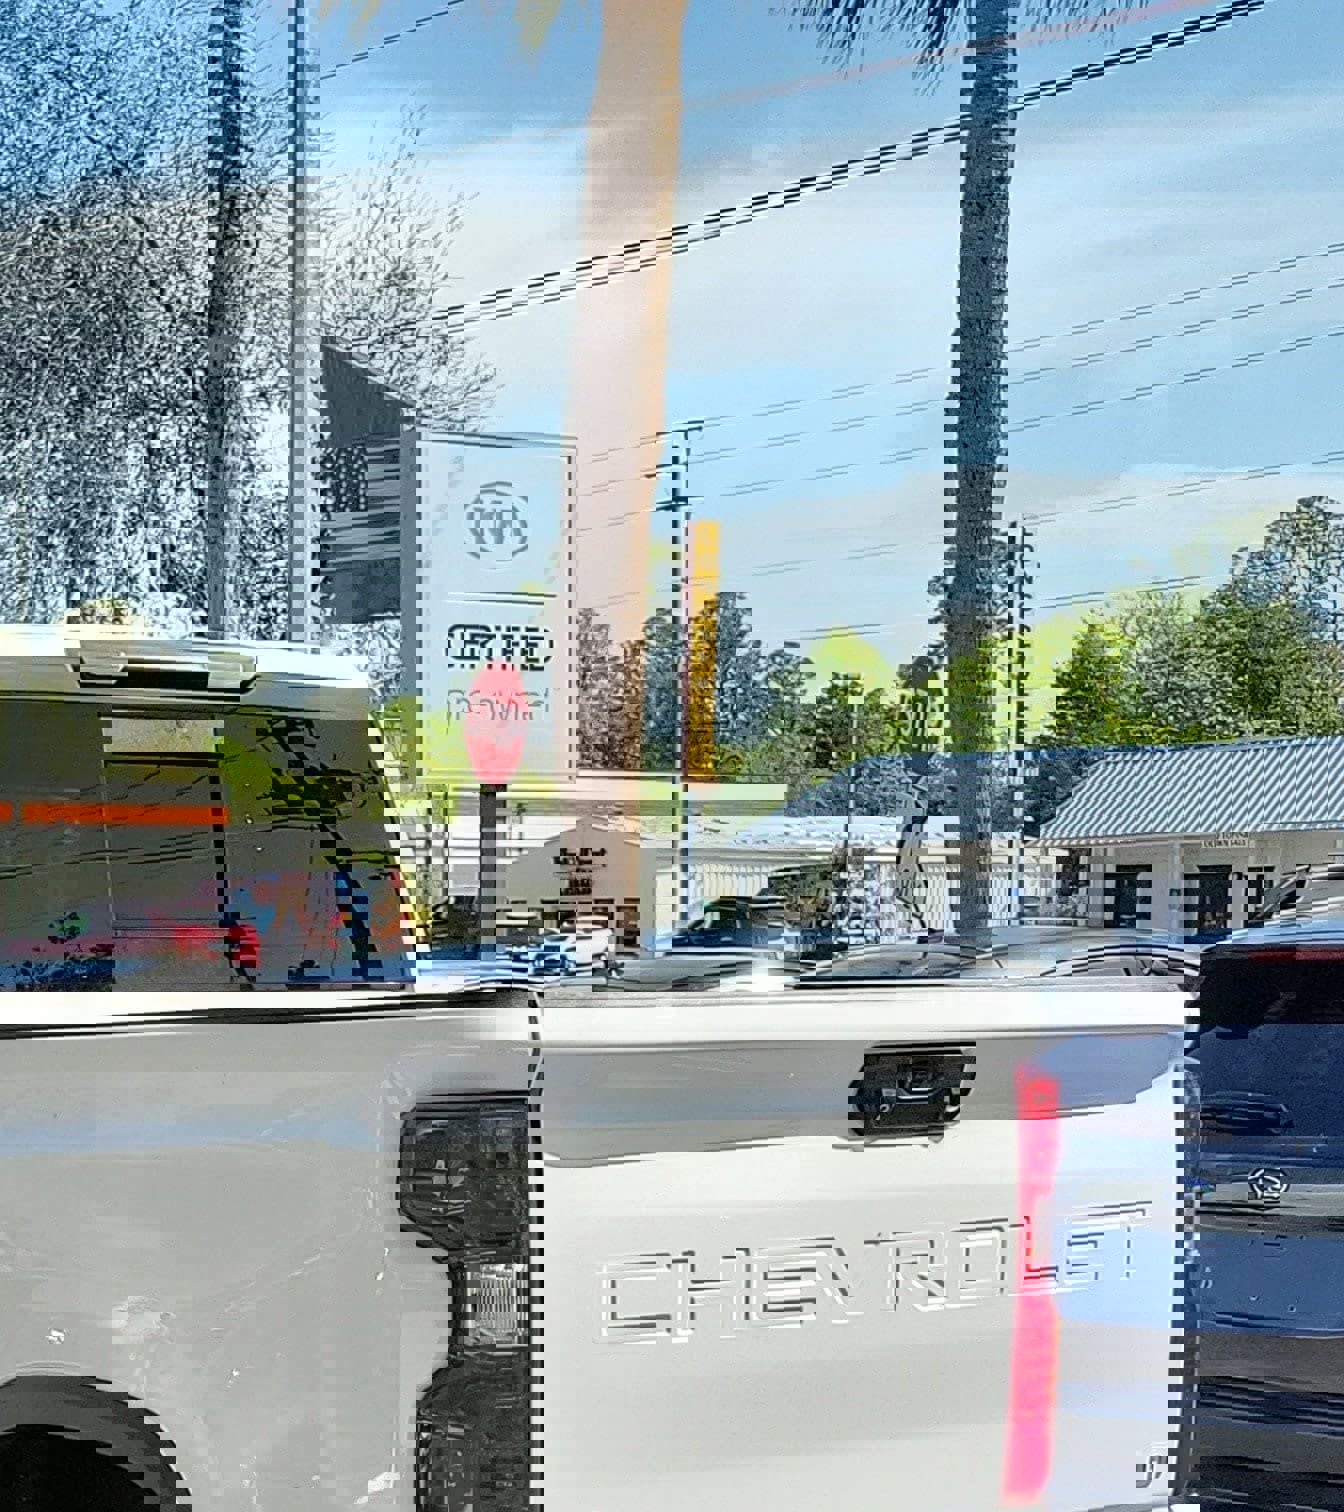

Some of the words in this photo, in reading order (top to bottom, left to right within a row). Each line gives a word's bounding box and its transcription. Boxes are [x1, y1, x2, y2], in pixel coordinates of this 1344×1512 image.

[692, 525, 716, 768] LONGSTREET
[467, 691, 525, 754] STOP
[453, 876, 491, 912] ONLY
[939, 1455, 985, 1490] LT
